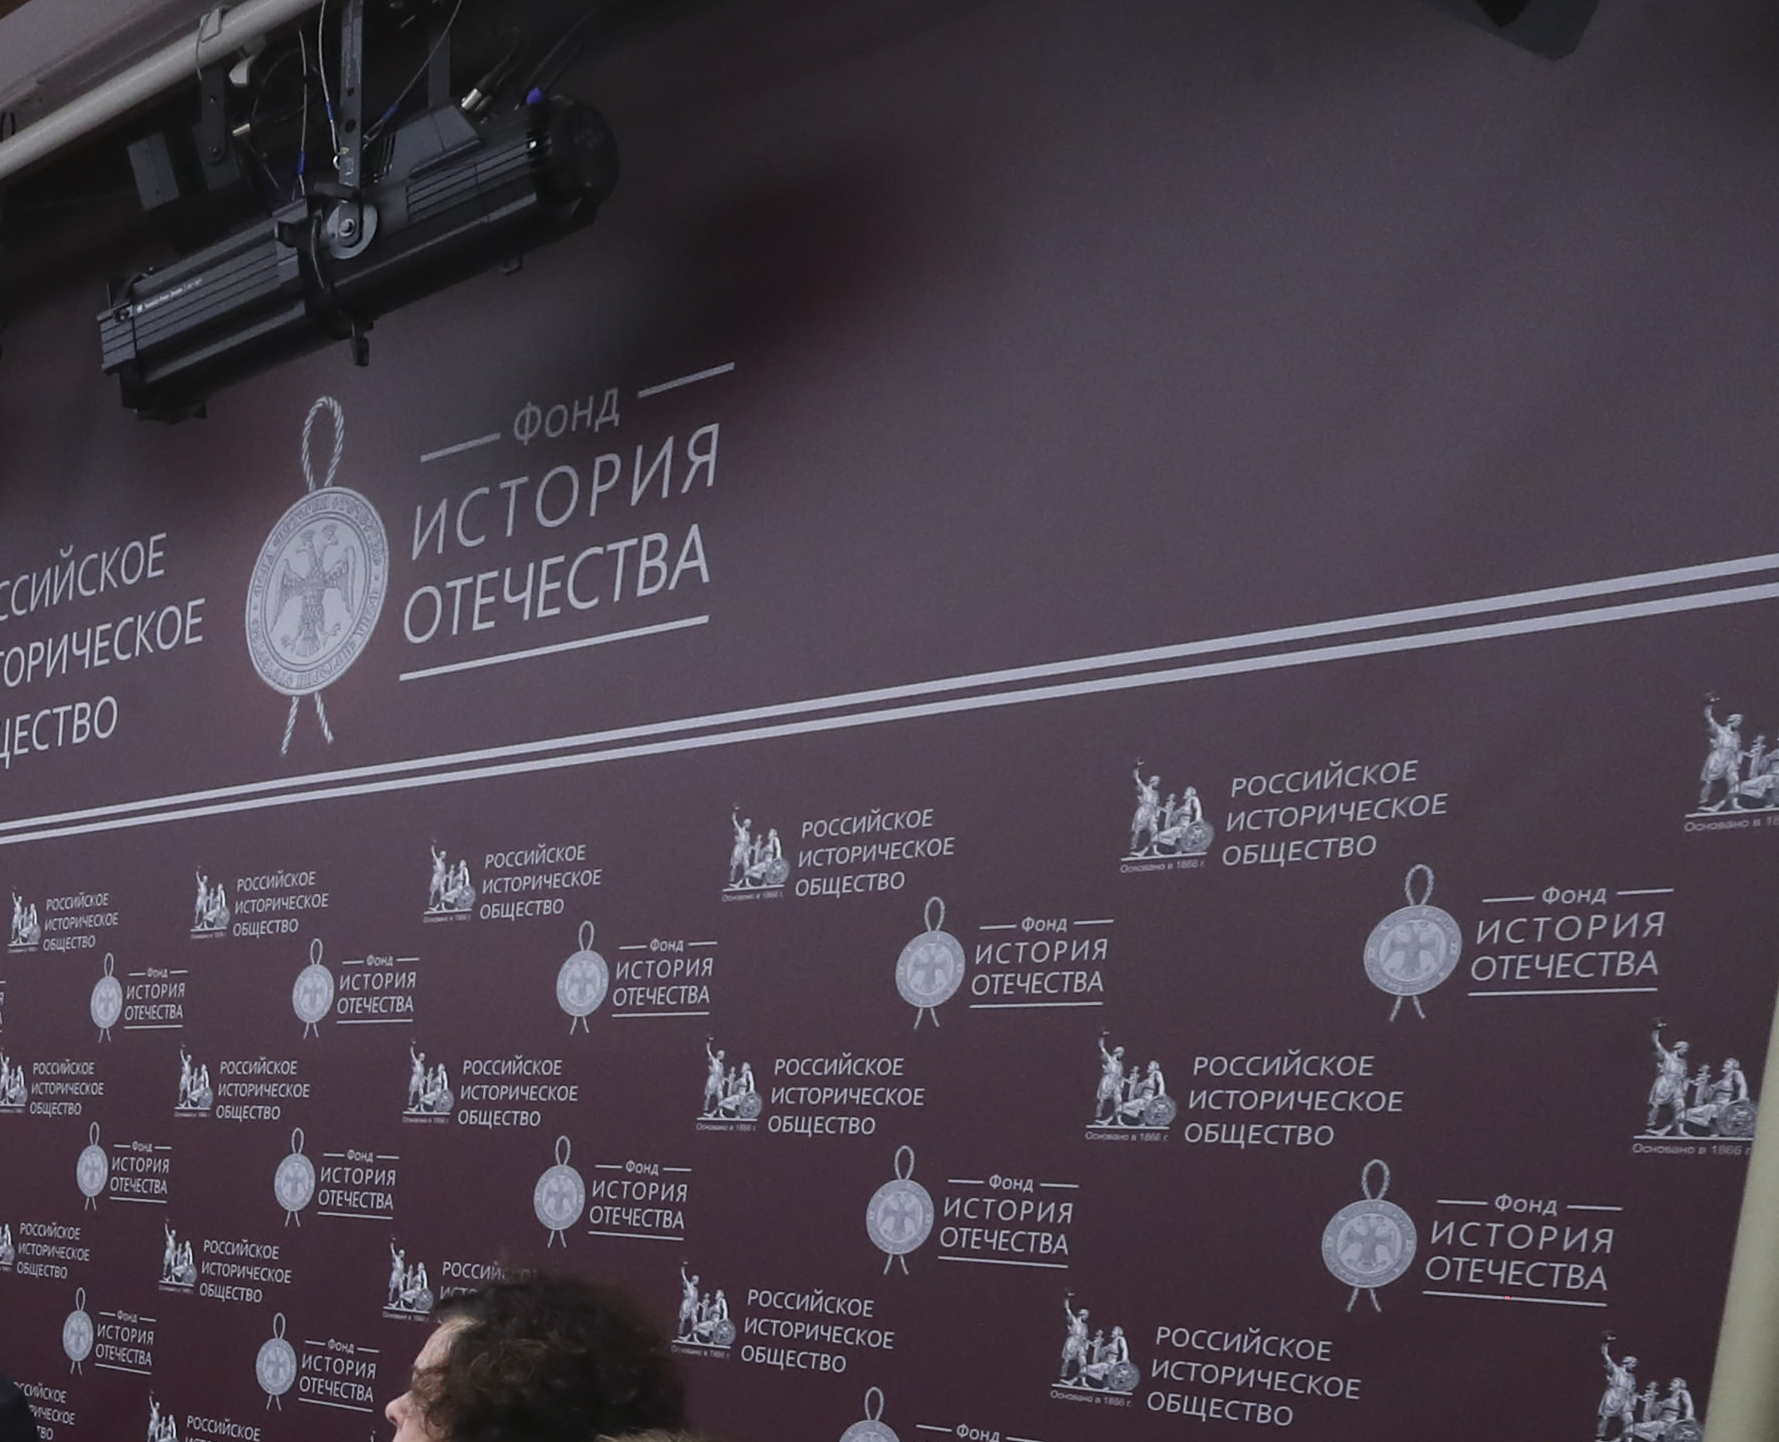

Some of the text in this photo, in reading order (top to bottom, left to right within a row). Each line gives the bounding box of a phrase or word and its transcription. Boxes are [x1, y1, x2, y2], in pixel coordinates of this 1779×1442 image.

[410, 422, 722, 560] ИСТОРИЯ
[401, 523, 712, 645] ОТЕЧЕСТВА
[1230, 759, 1418, 799] РОССИЙСКОЕ
[802, 808, 934, 839] РОССИЙСКОЕ
[1226, 794, 1449, 831] ИСТОРИЧЕСКОЕ
[485, 842, 586, 869] РОССИЙСКОЕ
[798, 838, 955, 868] ИСТОРИЧЕСКОЕ
[1221, 834, 1377, 871] ОБЩЕСТВО
[237, 869, 316, 891] РОССИЙСКОЕ
[482, 869, 602, 894] ИСТОРИЧЕСКОЕ
[795, 871, 906, 899] ОБЩЕСТВО
[46, 891, 109, 910] РОССИЙСКОЕ
[234, 893, 329, 914] ИСТОРИЧЕСКОЕ
[479, 899, 565, 921] ОБЩЕСТВО
[44, 912, 118, 932] ИСТОРИЧЕСКОЕ
[233, 918, 299, 939] ОБЩЕСТВО
[1475, 911, 1665, 946] ИСТОРИЯ
[43, 935, 96, 952] ОБЩЕСТВО
[974, 937, 1108, 966] ИСТОРИЯ
[616, 957, 713, 980] ИСТОРИЯ
[1470, 949, 1658, 984] ОТЕЧЕСТВА
[126, 982, 185, 999] ИСТОРИЯ
[339, 971, 416, 991] ИСТОРИЯ
[970, 969, 1103, 997] ОТЕЧЕСТВА
[337, 996, 414, 1015] ОТЕЧЕСТВА
[612, 984, 710, 1007] ОТЕЧЕСТВА
[124, 1003, 183, 1021] ОТЕЧЕСТВА
[774, 1052, 904, 1077] РОССИЙСКОЕ
[1193, 1049, 1375, 1077] РОССИЙСКОЕ
[771, 1087, 925, 1107] ИСТОРИЧЕСКОЕ
[1189, 1090, 1403, 1114] ИСТОРИЧЕСКОЕ
[767, 1115, 876, 1138] ОБЩЕСТВО
[1184, 1123, 1334, 1149] ОБЩЕСТВО
[944, 1197, 1073, 1224] ИСТОРИЯ
[940, 1226, 1069, 1256] ОТЕЧЕСТВА
[1429, 1221, 1614, 1255] ИСТОРИЯ
[1425, 1255, 1608, 1292] ОТЕЧЕСТВА
[747, 1288, 874, 1318] РОССИЙСКОЕ
[744, 1317, 894, 1351] ИСТОРИЧЕСКОЕ
[1155, 1325, 1332, 1363] РОССИЙСКОЕ
[741, 1345, 847, 1374] ОБЩЕСТВО
[1151, 1359, 1361, 1401] ИСТОРИЧЕСКОЕ
[1146, 1391, 1294, 1428] ОБЩЕСТВО
